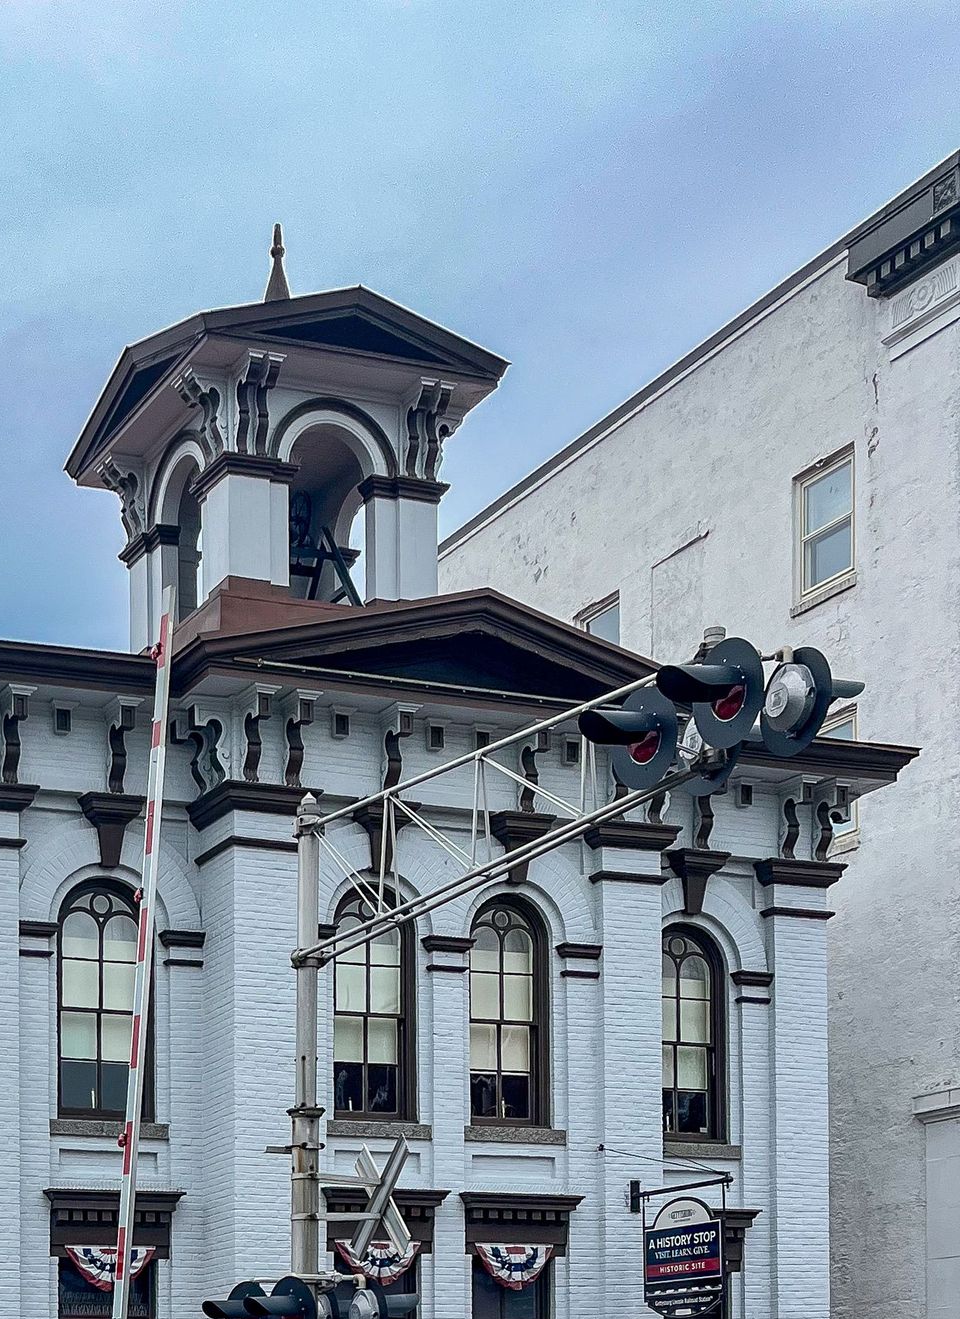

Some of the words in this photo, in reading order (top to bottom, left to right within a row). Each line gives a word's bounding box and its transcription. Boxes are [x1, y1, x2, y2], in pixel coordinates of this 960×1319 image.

[649, 1240, 656, 1250] A
[656, 1234, 692, 1248] HISTORY
[693, 1231, 716, 1244] STOP
[660, 1264, 690, 1273] HISTORIC
[691, 1262, 706, 1270] SITE
